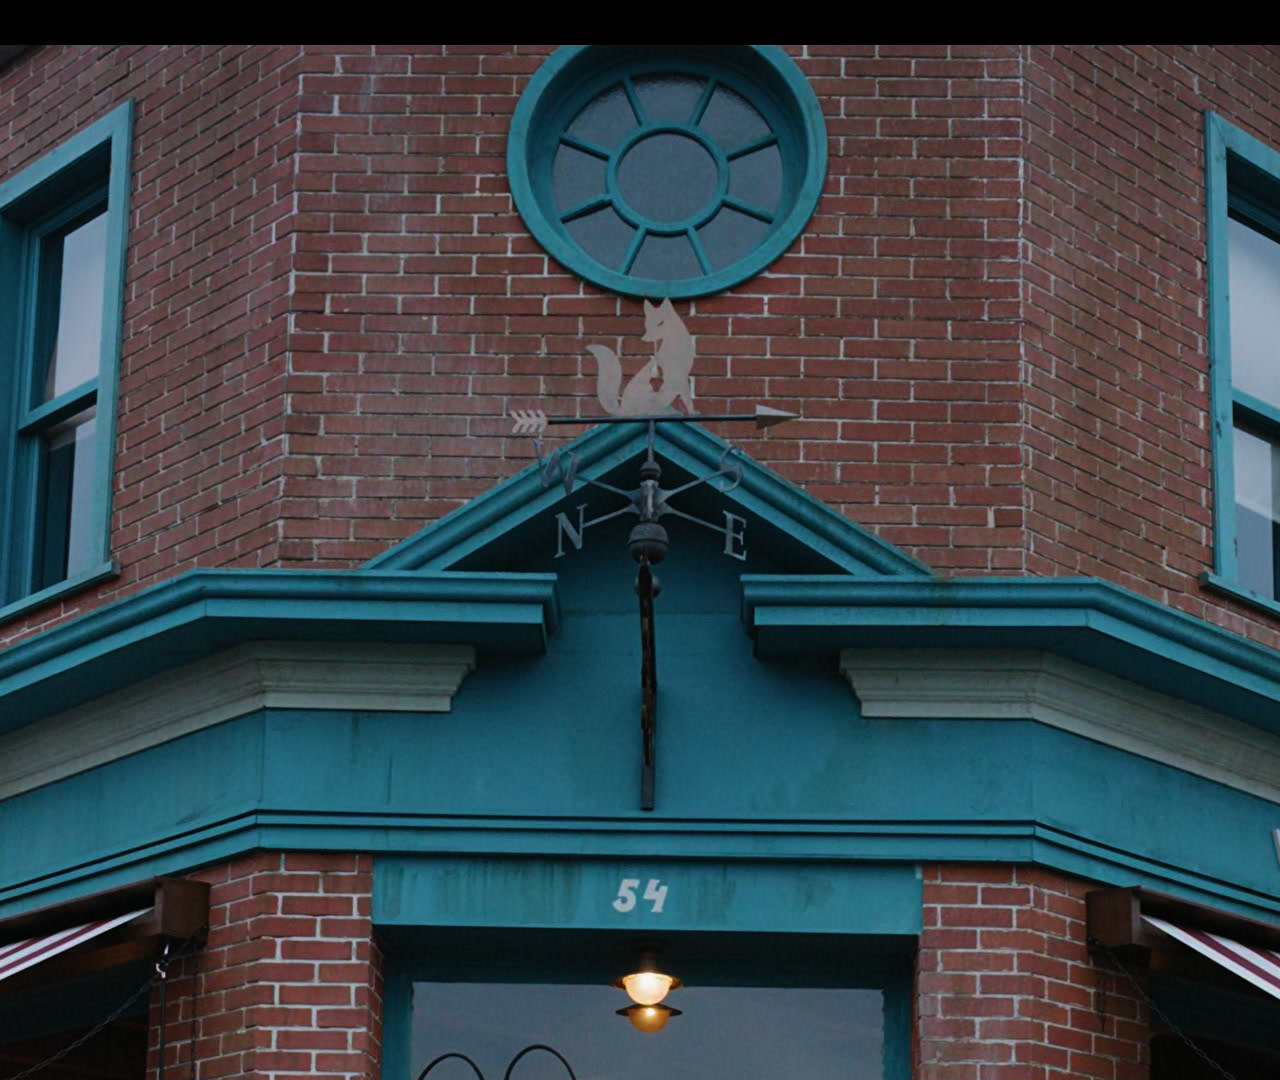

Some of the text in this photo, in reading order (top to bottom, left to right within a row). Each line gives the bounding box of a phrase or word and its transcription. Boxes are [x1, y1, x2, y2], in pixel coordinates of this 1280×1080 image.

[553, 504, 588, 559] N
[722, 510, 747, 561] E
[612, 878, 669, 912] 54
